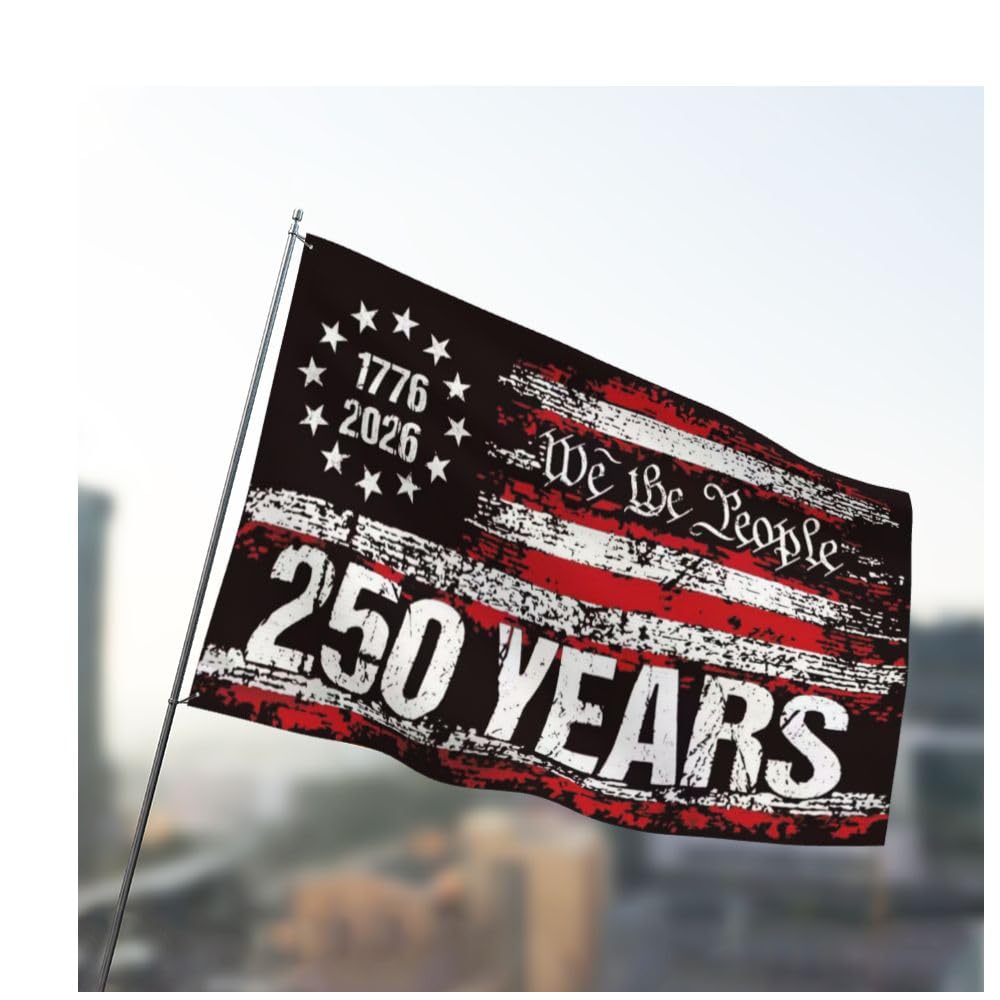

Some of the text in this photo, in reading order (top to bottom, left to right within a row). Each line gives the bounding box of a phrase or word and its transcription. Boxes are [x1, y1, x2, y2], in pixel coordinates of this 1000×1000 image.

[338, 398, 420, 464] 2026
[357, 352, 428, 413] 1776
[539, 428, 844, 577] We the People
[244, 544, 849, 799] 250 YEARS
